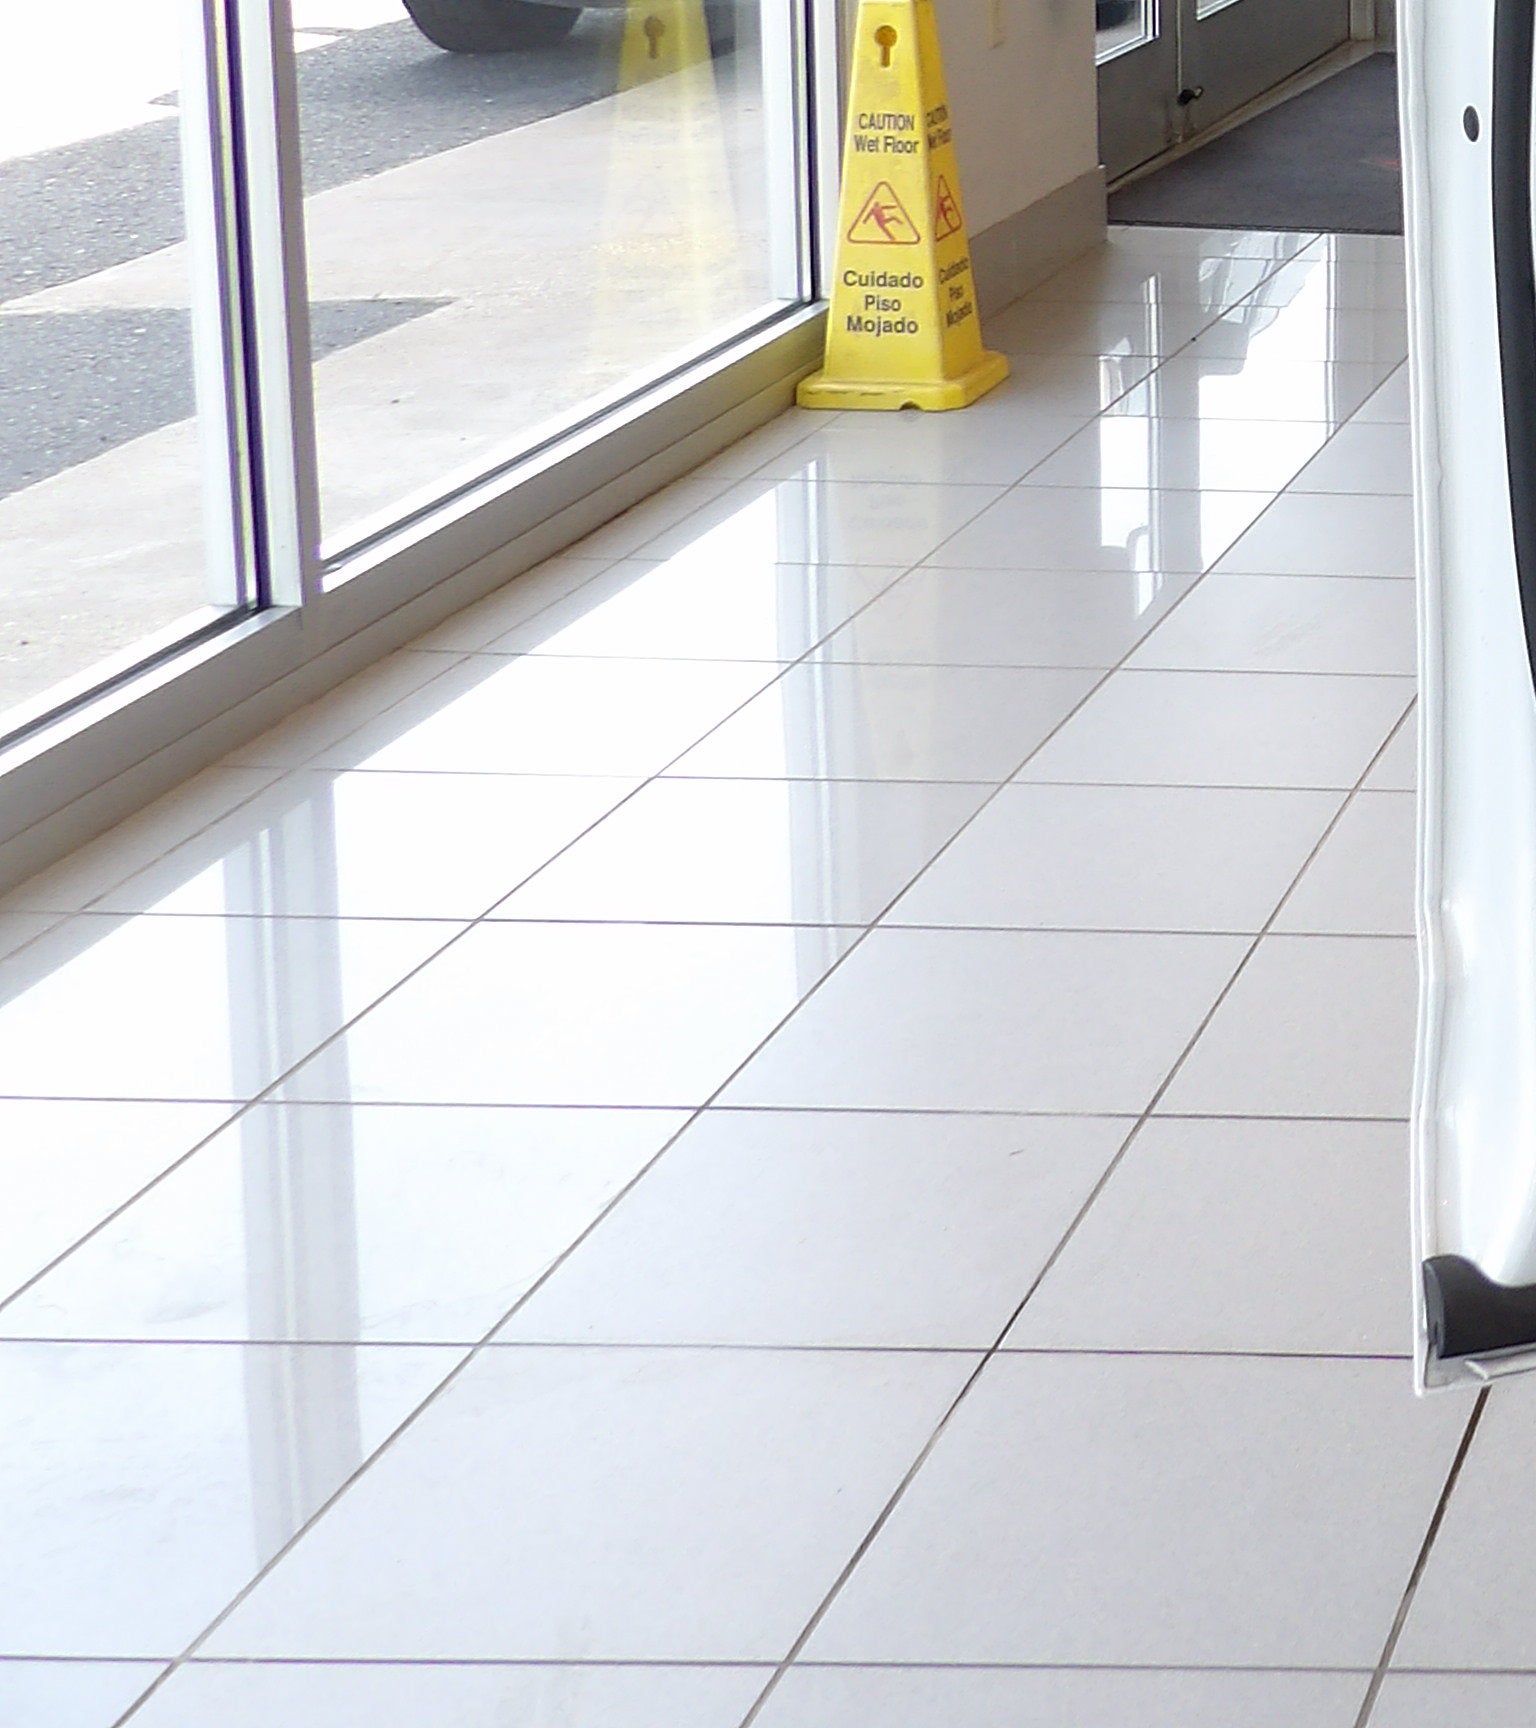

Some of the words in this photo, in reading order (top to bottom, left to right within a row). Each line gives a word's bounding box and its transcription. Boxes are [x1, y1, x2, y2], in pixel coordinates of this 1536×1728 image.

[858, 113, 915, 131] CAUTION
[854, 135, 880, 153] Wet
[883, 137, 918, 154] Floor
[843, 271, 923, 290] Cuidado
[864, 294, 901, 312] Piso
[847, 316, 918, 337] Mojado
